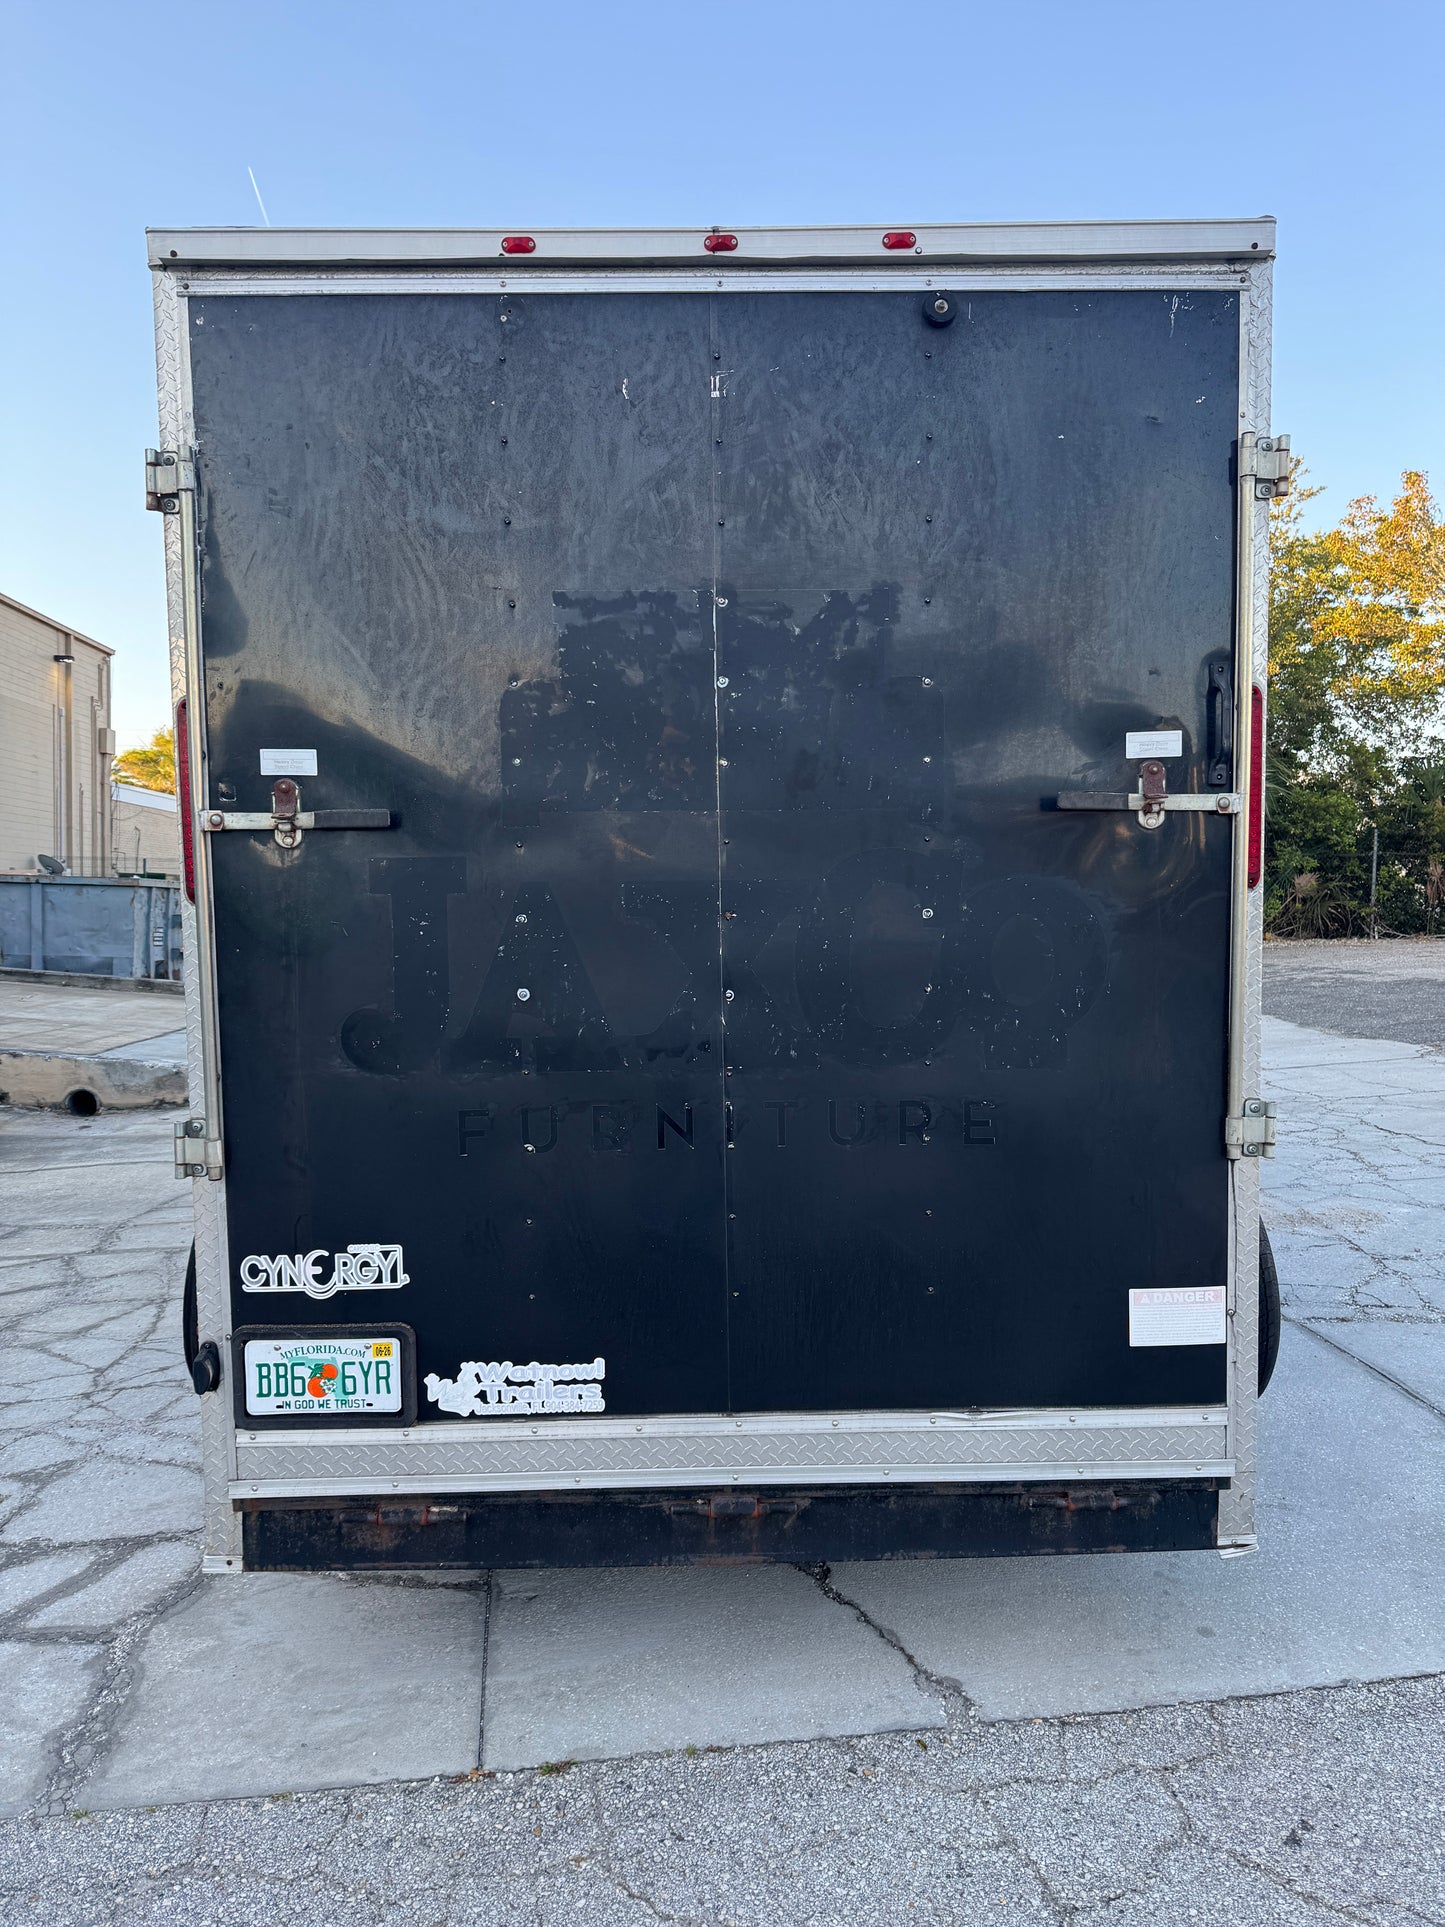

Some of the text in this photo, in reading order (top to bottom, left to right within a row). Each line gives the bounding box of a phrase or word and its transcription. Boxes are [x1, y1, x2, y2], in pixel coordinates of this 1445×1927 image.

[456, 1098, 998, 1157] FURNITURE
[241, 1249, 399, 1292] CYNERGY
[1152, 1290, 1216, 1304] DANGER
[279, 1344, 367, 1360] MYFLORIDA.COM
[375, 1346, 392, 1357] 06-26
[255, 1360, 392, 1398] BB6 6YR
[477, 1358, 604, 1382] Watnow!
[480, 1381, 602, 1402] Trailers
[282, 1398, 366, 1410] IN GOD WE TRUST
